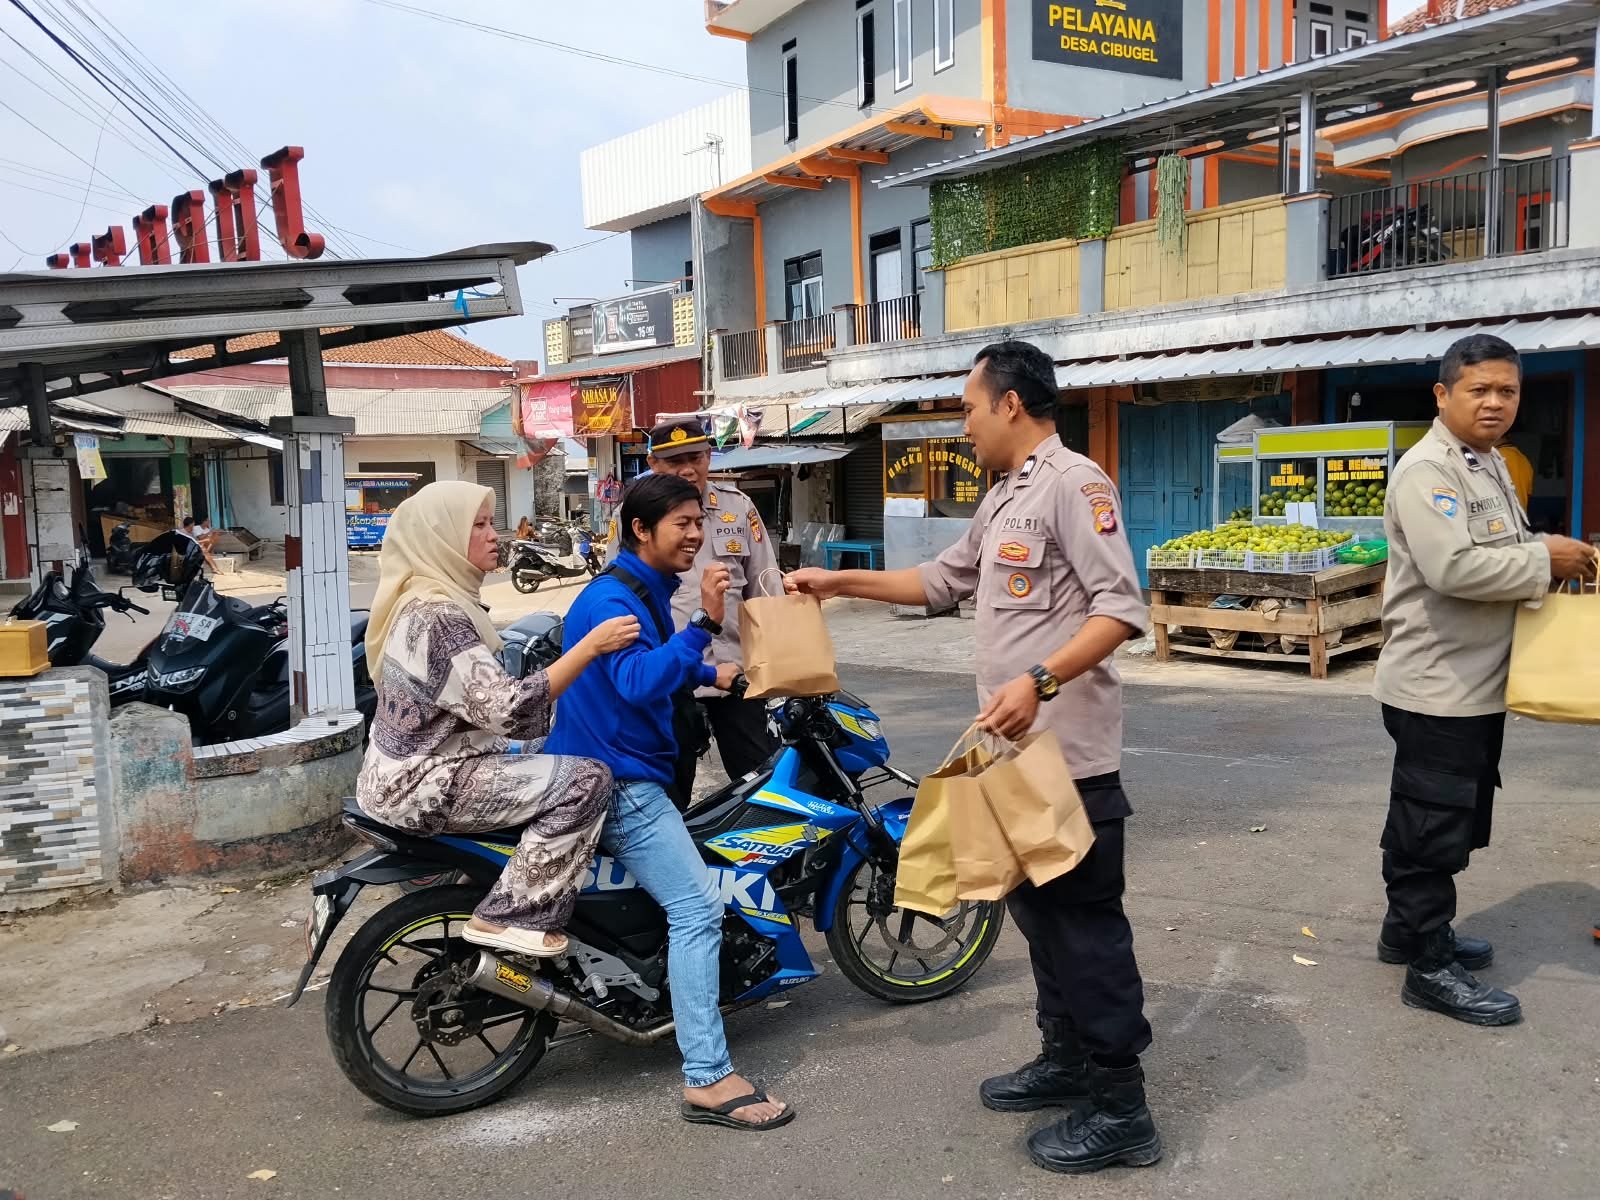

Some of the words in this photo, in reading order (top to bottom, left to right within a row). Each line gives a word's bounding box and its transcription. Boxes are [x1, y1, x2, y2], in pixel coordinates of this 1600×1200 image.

[1048, 4, 1157, 43] PELAYANA
[1060, 35, 1098, 54] DESA
[1100, 41, 1159, 63] CIBUGEL
[581, 387, 608, 404] SARASA
[928, 450, 982, 479] GORENGAN
[1280, 463, 1294, 475] ES
[1350, 470, 1385, 480] KUNING
[716, 527, 745, 536] POLRI
[1003, 517, 1039, 531] POLRI
[723, 835, 793, 857] SATRIA
[779, 976, 811, 986] SUZUKI
